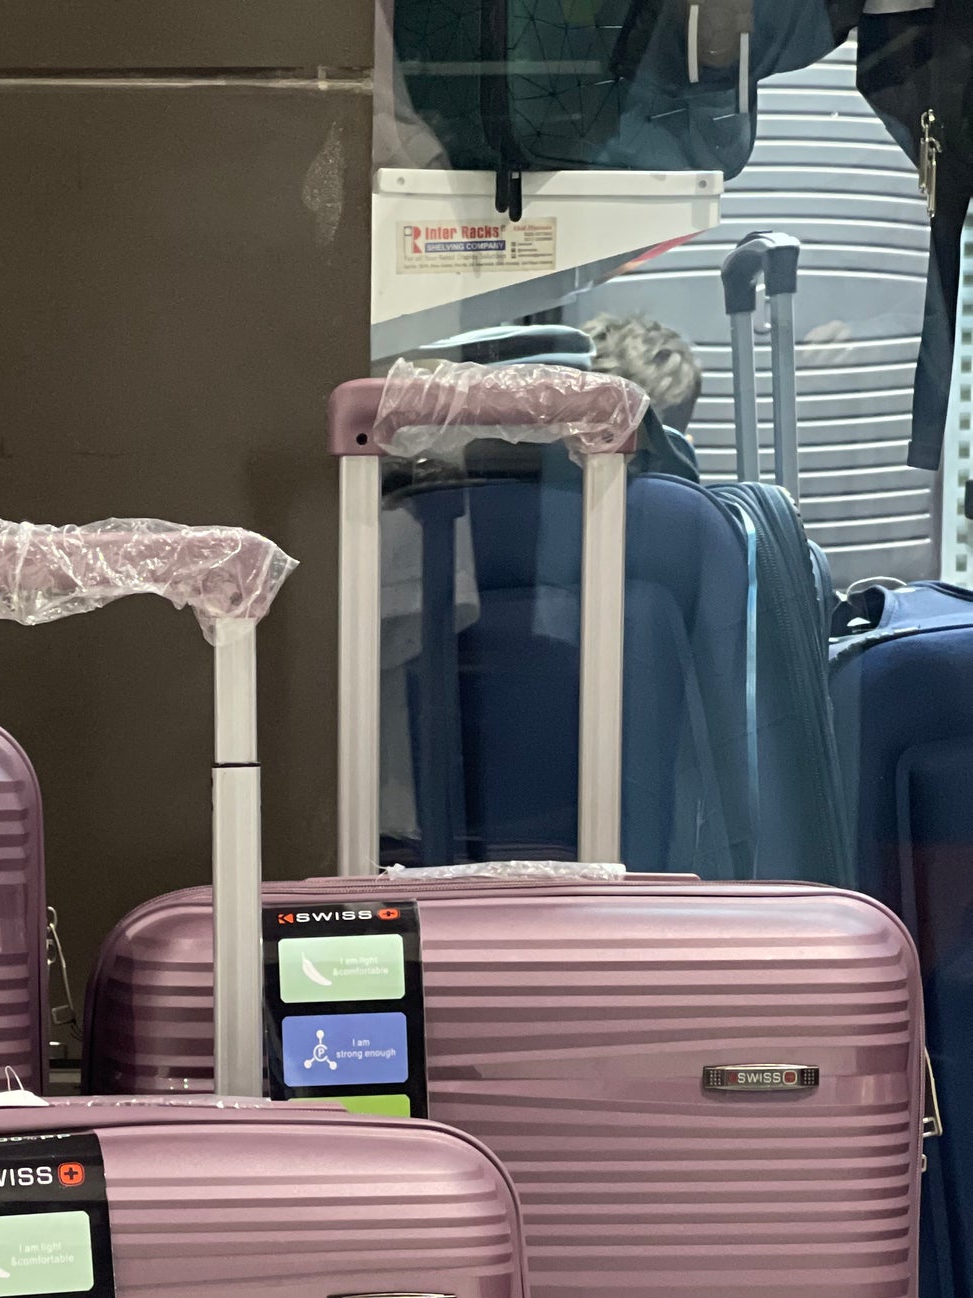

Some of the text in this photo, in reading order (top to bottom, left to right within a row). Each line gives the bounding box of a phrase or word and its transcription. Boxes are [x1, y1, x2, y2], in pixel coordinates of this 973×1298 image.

[425, 227, 457, 240] Inter
[427, 243, 465, 252] SHELVING
[465, 242, 504, 251] COMPANY
[344, 957, 358, 965] am
[359, 955, 378, 966] light
[352, 1038, 371, 1047] I am
[336, 1048, 397, 1060] strong enough
[24, 1244, 40, 1253] am
[41, 1242, 62, 1254] light
[11, 1254, 75, 1267] &comfortable
